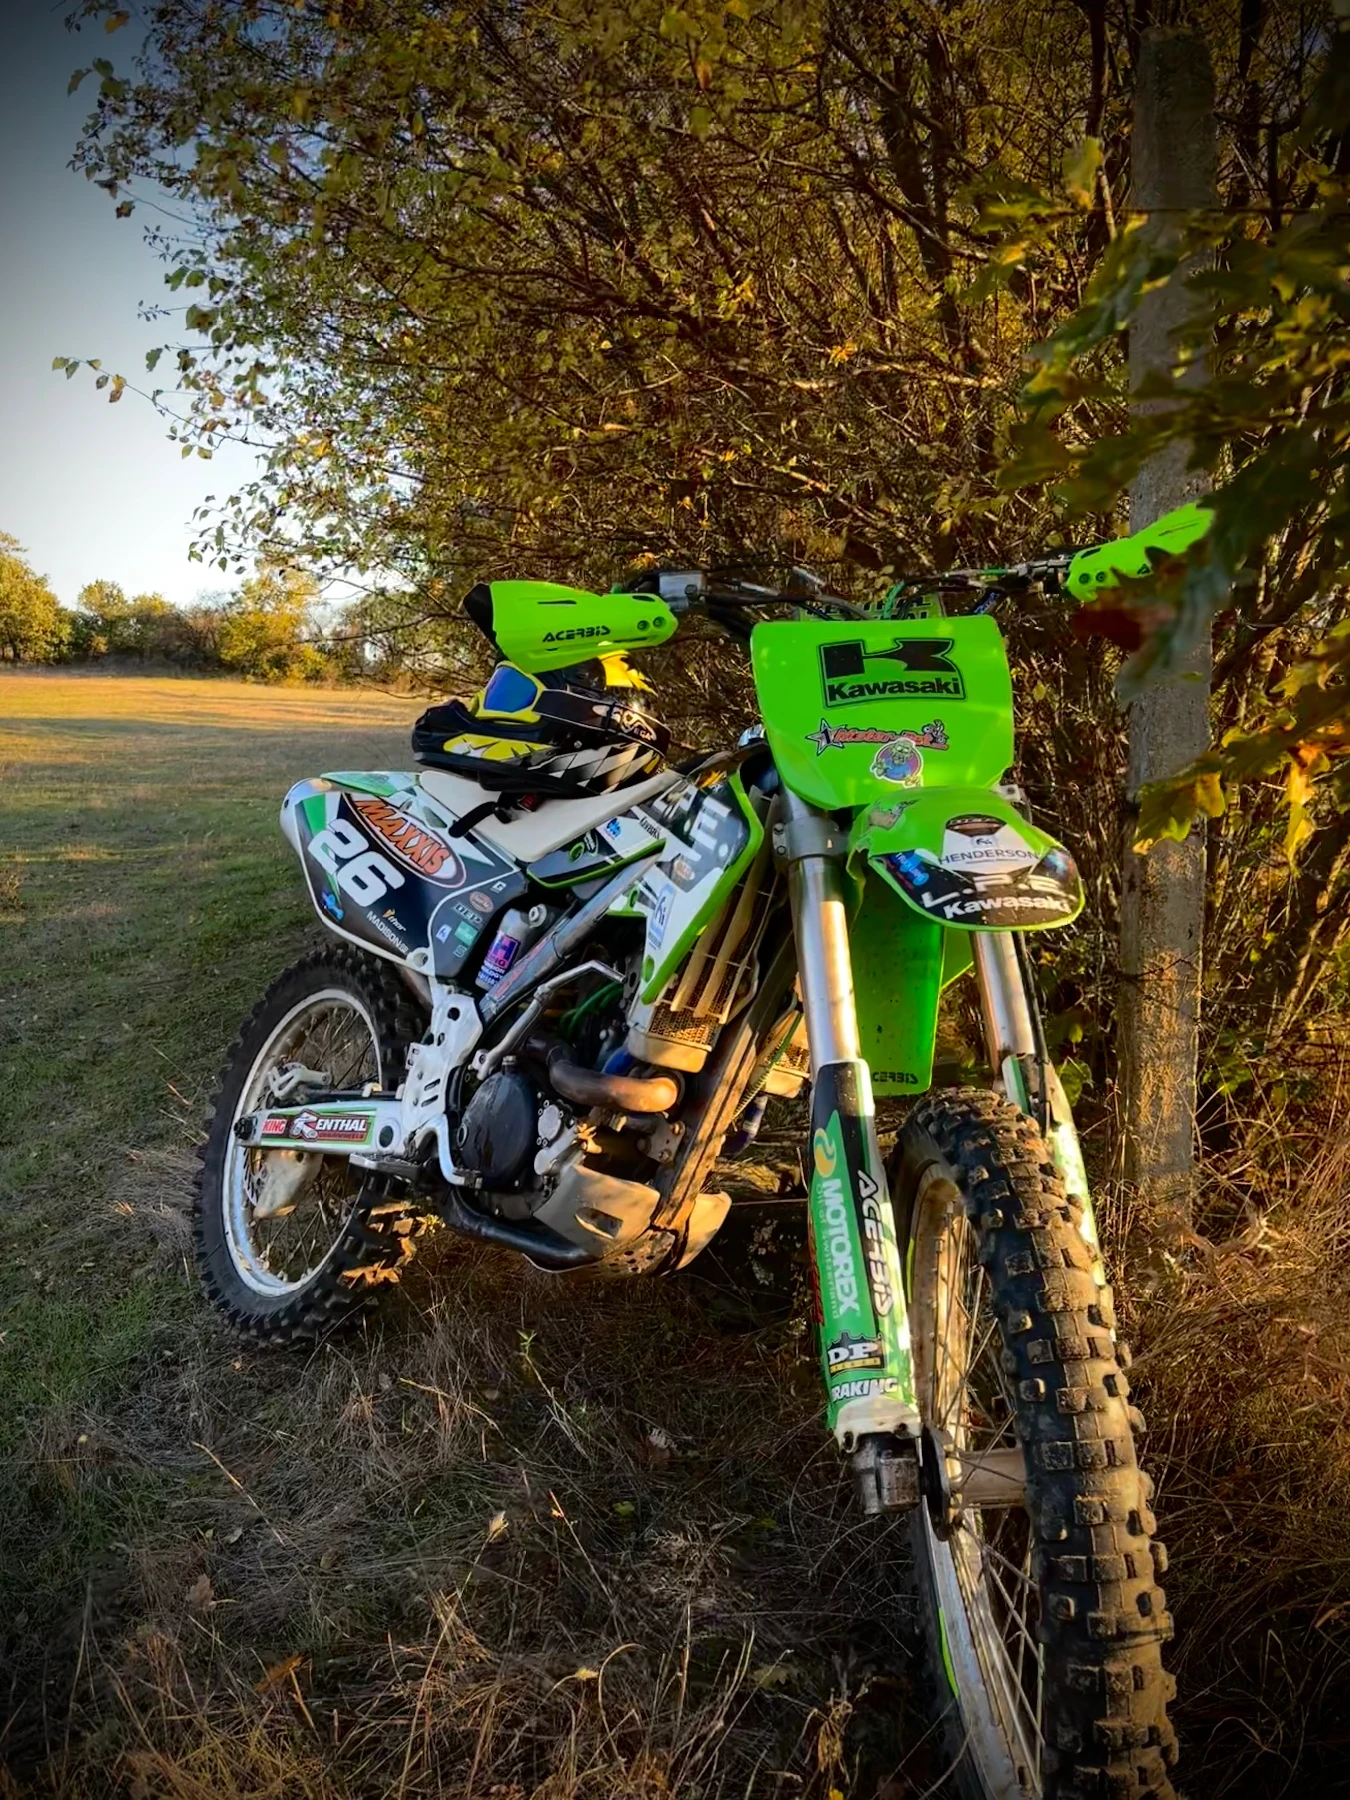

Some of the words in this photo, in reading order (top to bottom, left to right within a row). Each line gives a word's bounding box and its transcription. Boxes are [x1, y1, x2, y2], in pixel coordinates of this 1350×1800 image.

[542, 625, 611, 643] ACERBIS
[827, 678, 961, 702] Kawasaki
[354, 799, 452, 875] MAXXIS
[307, 818, 406, 907] 26
[939, 848, 1040, 865] HENDERSON
[943, 896, 1072, 919] Kawasaki
[366, 911, 402, 949] MADISON
[872, 1071, 919, 1085] CERBIS
[292, 1111, 367, 1138] RENTHAL
[823, 1179, 859, 1316] MOTOREX
[857, 1169, 893, 1317] ACERBIS
[831, 1378, 898, 1402] RAKING
